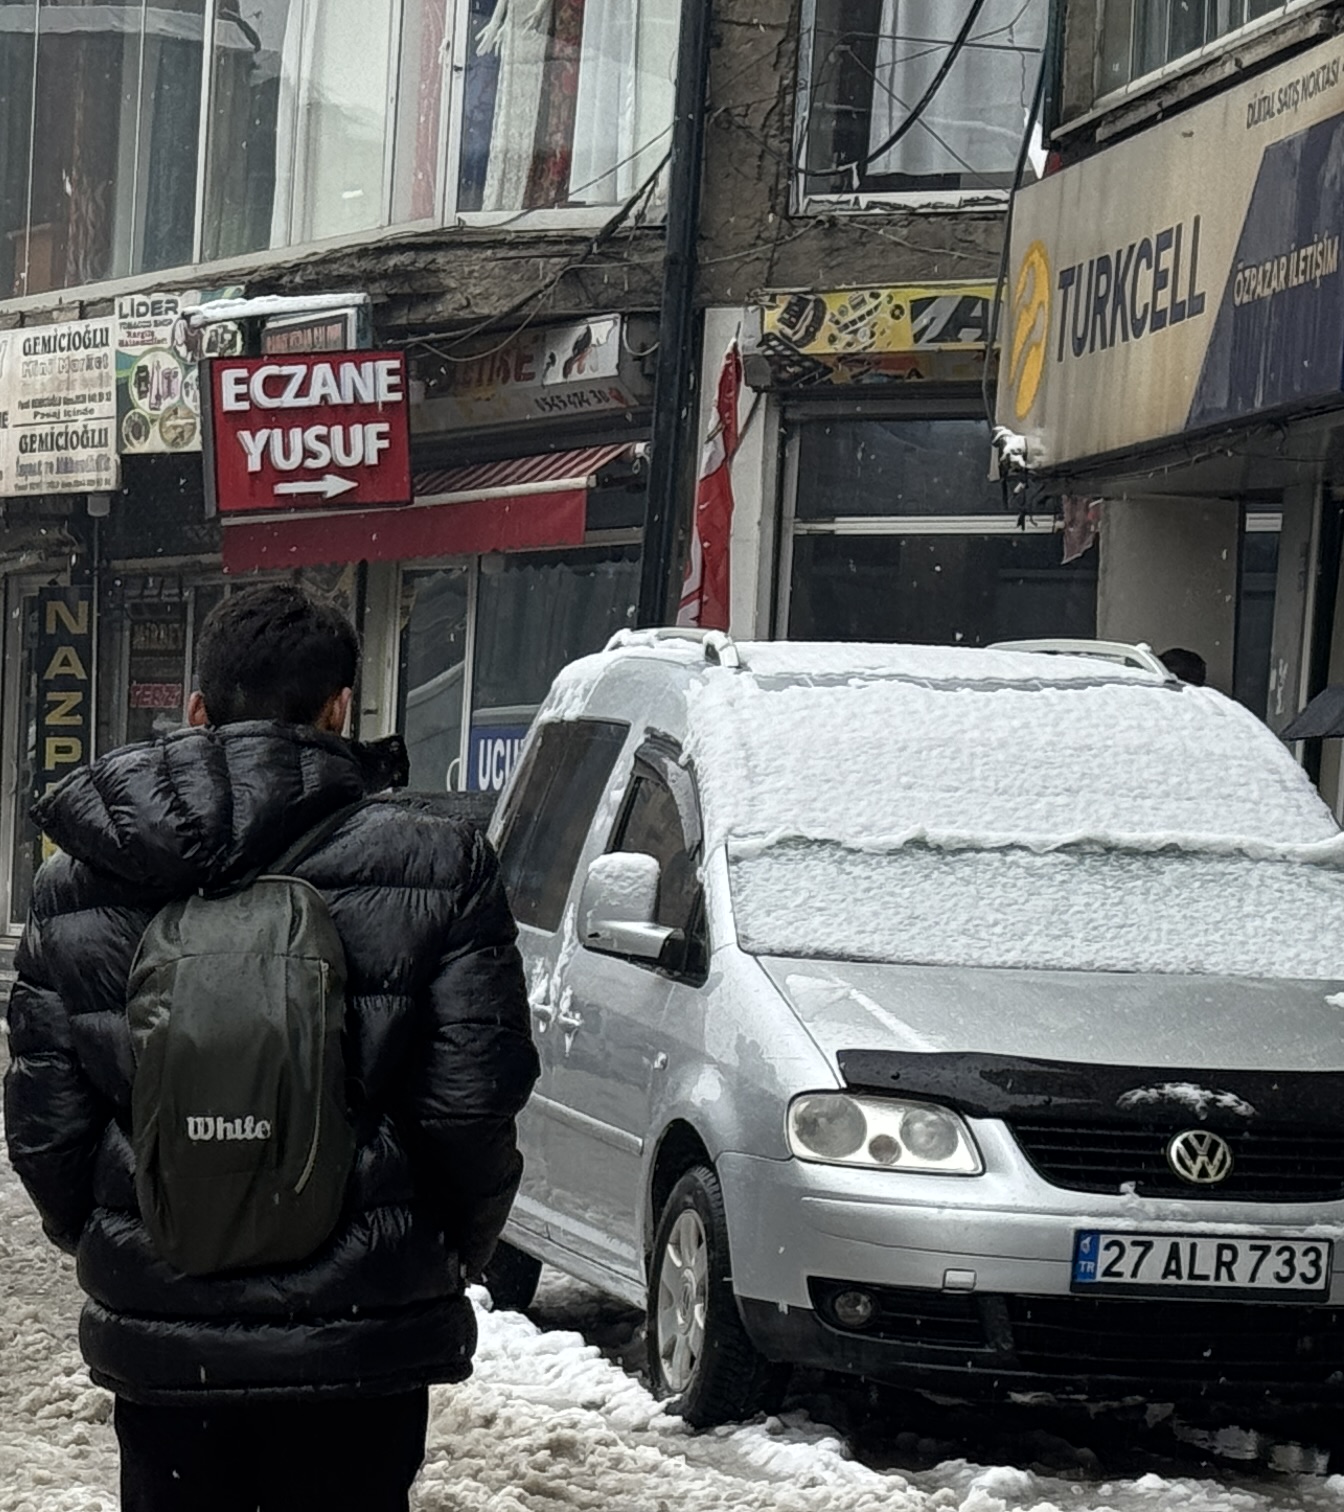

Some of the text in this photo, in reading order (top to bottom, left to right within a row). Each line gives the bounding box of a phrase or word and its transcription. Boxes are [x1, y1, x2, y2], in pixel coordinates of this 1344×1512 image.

[1276, 78, 1300, 115] SATIŞ
[1301, 57, 1341, 104] NOKTASI
[1057, 215, 1206, 363] TURKCELL
[1233, 230, 1340, 307] ÖZPAZAR İLETİŞİM
[22, 323, 110, 356] GEMİCİOĞLU
[220, 358, 404, 413] ECZANE
[18, 424, 109, 454] GEMİCİOĞLU
[237, 422, 392, 472] YUSUF
[43, 600, 89, 790] NAZP
[478, 738, 524, 791] UCU
[186, 1115, 272, 1141] White
[1079, 1260, 1095, 1275] TR
[1100, 1239, 1323, 1285] 27 ALR 733
